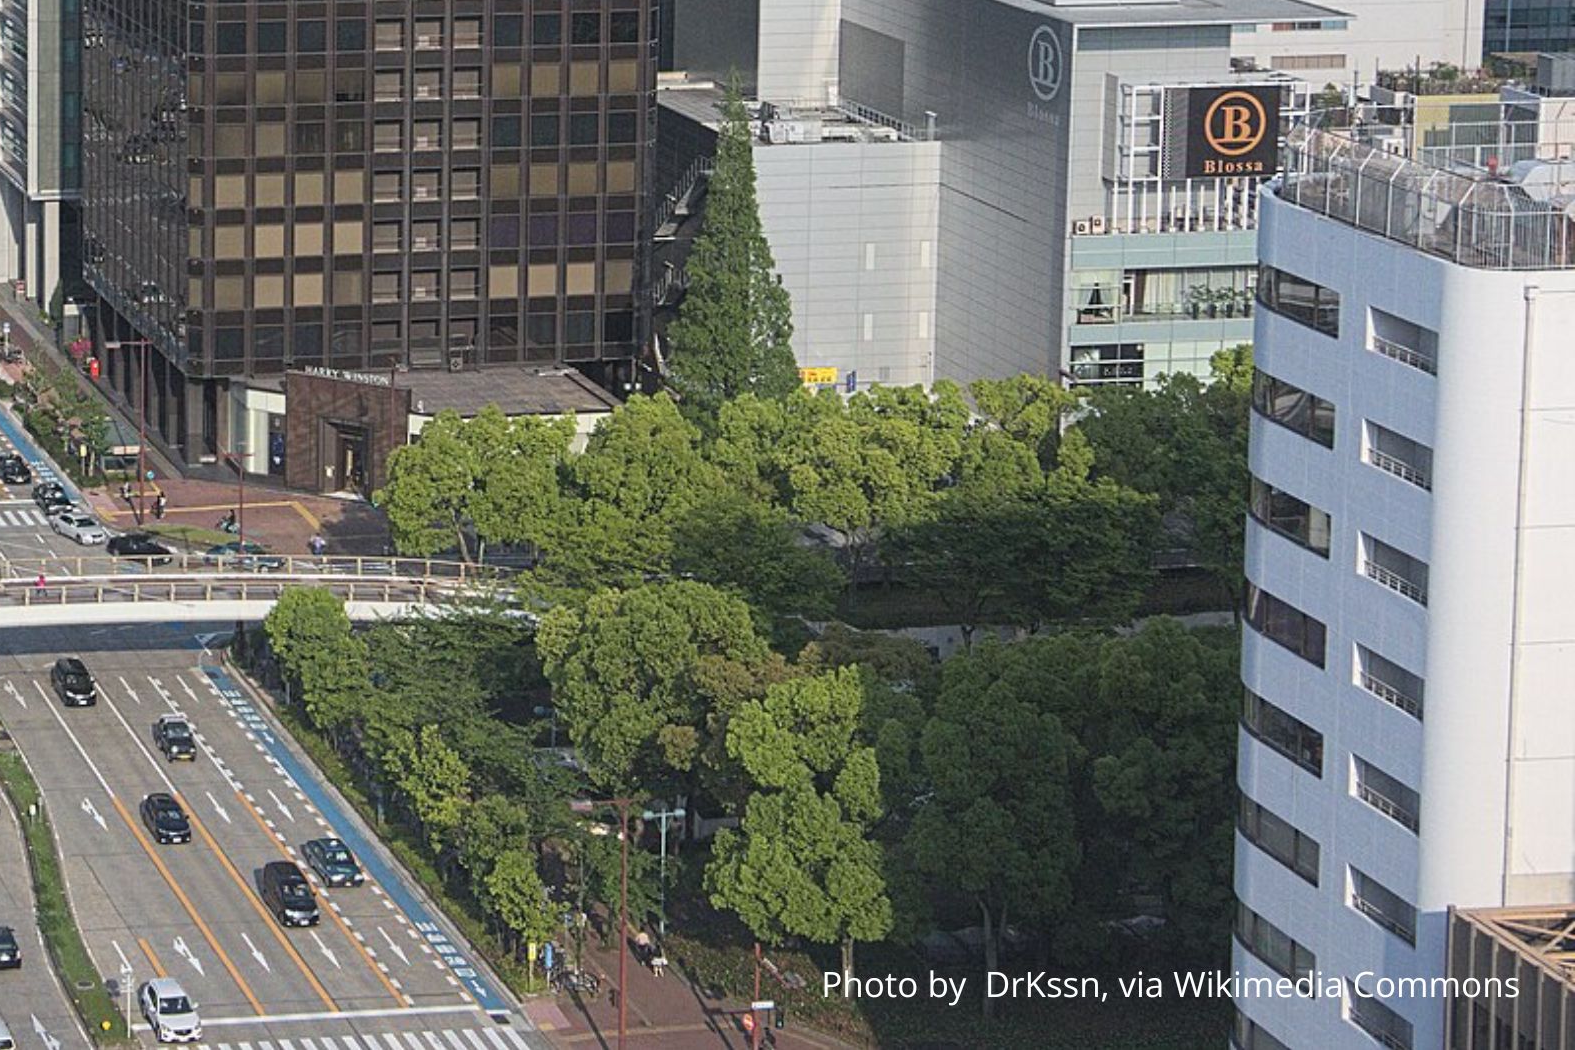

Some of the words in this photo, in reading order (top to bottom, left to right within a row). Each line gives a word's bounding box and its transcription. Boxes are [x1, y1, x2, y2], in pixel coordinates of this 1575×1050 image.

[1204, 160, 1263, 174] Blossa
[305, 365, 339, 379] HARRY
[342, 371, 389, 385] WINSTON
